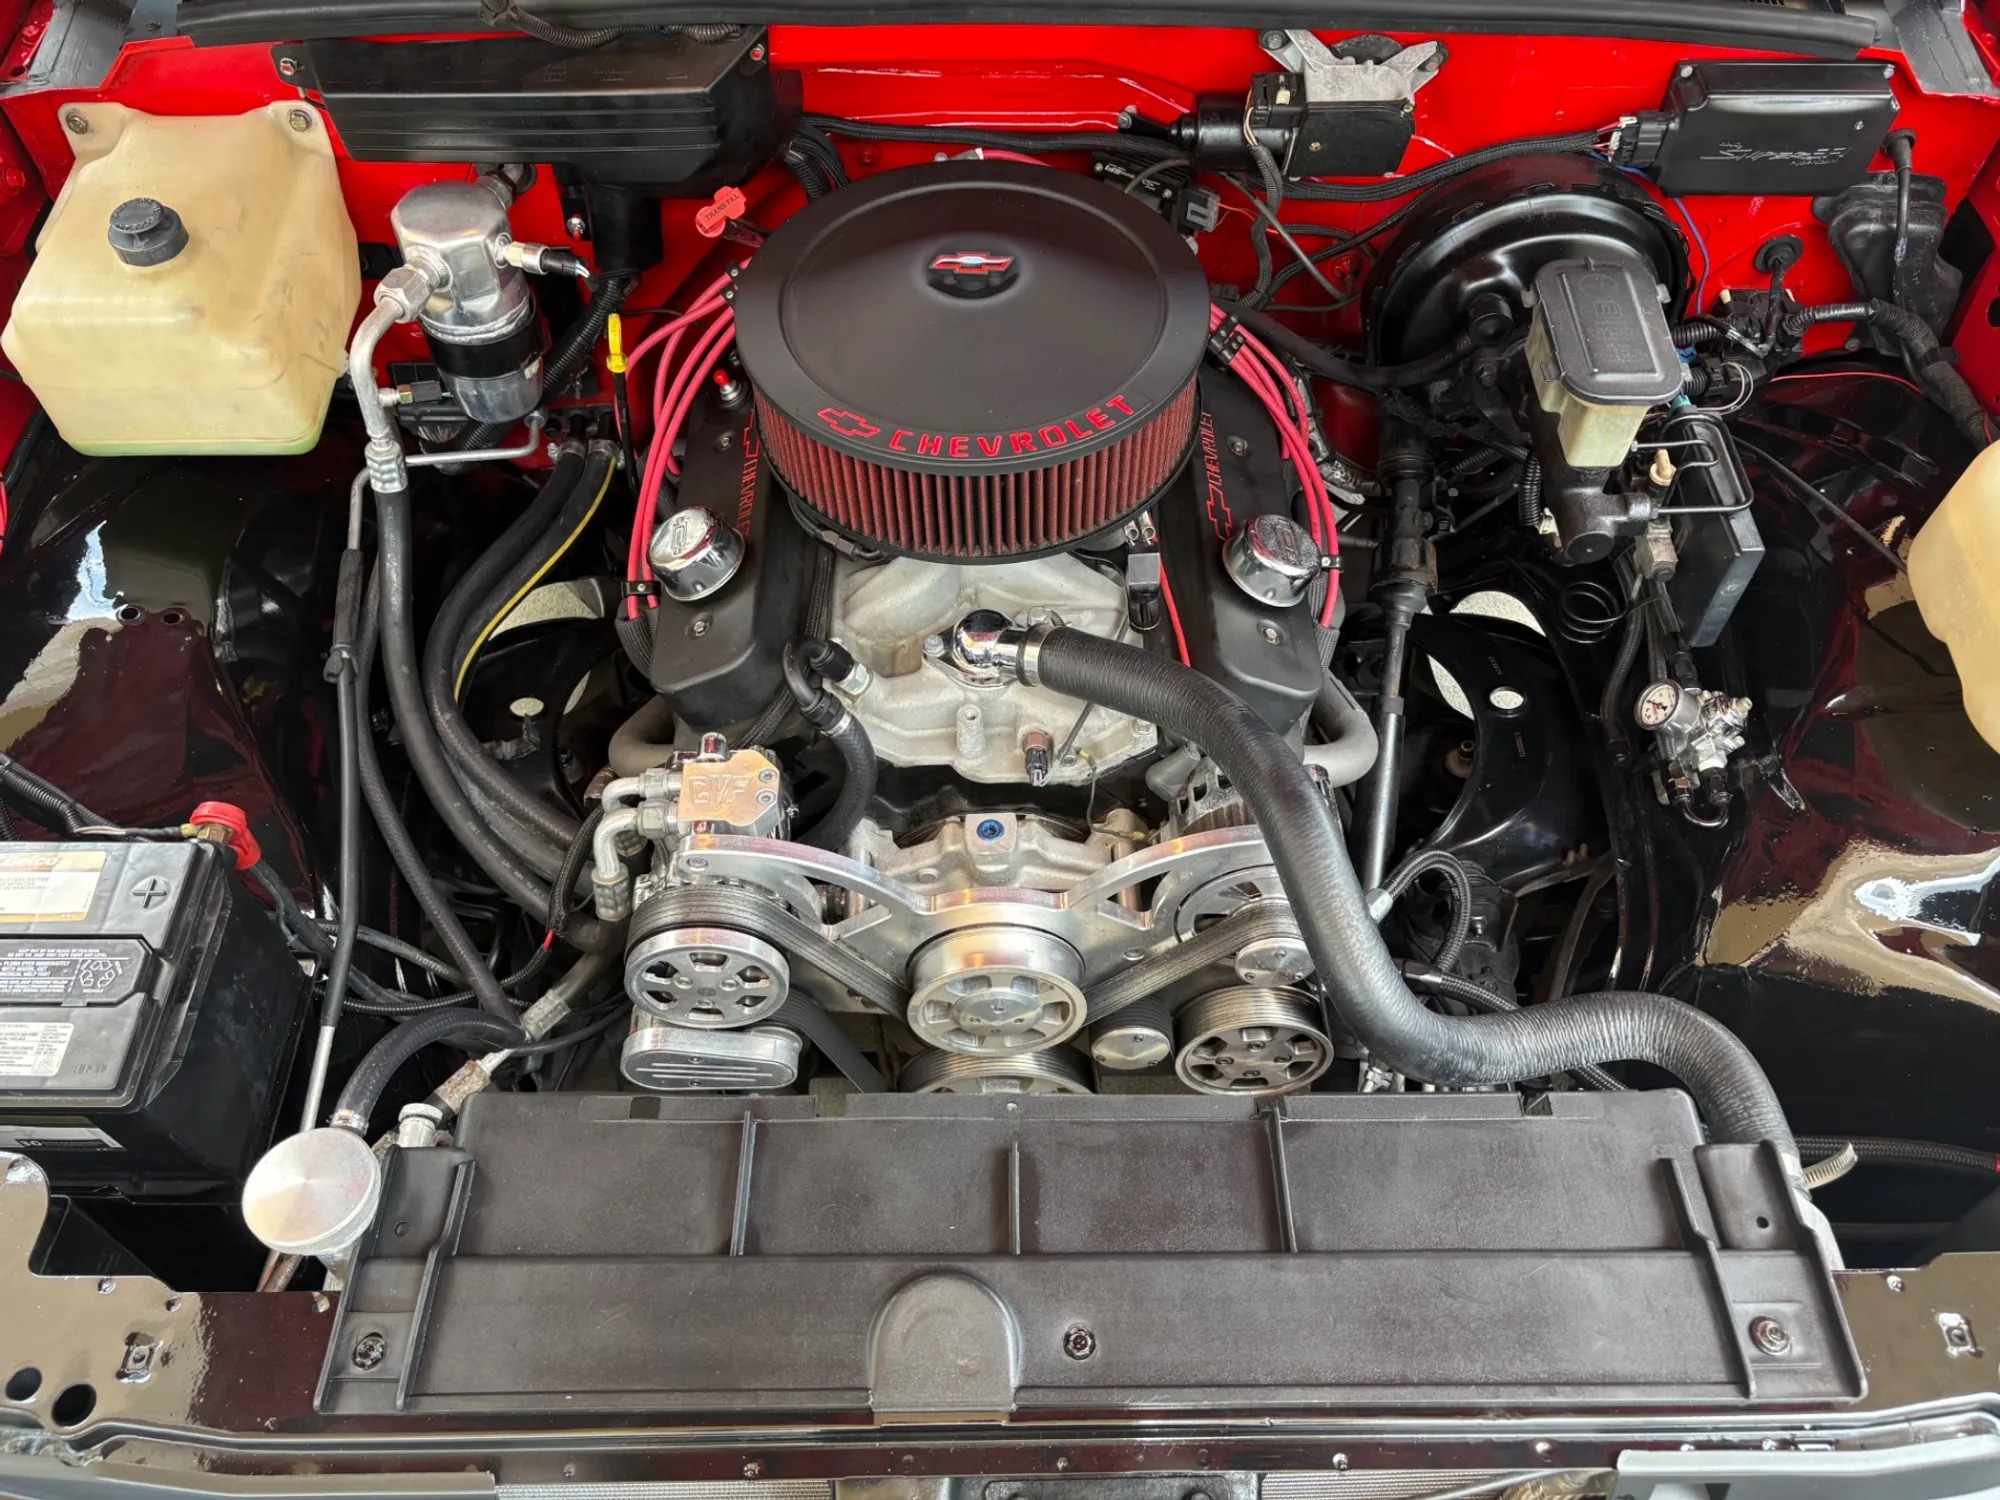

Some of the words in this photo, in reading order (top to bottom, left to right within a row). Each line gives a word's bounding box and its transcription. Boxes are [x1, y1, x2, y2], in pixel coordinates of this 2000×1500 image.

[705, 201, 728, 220] TRANS
[725, 194, 740, 207] FILL
[888, 394, 1135, 457] CHEVROLET
[1199, 411, 1223, 487] CHEVROLET
